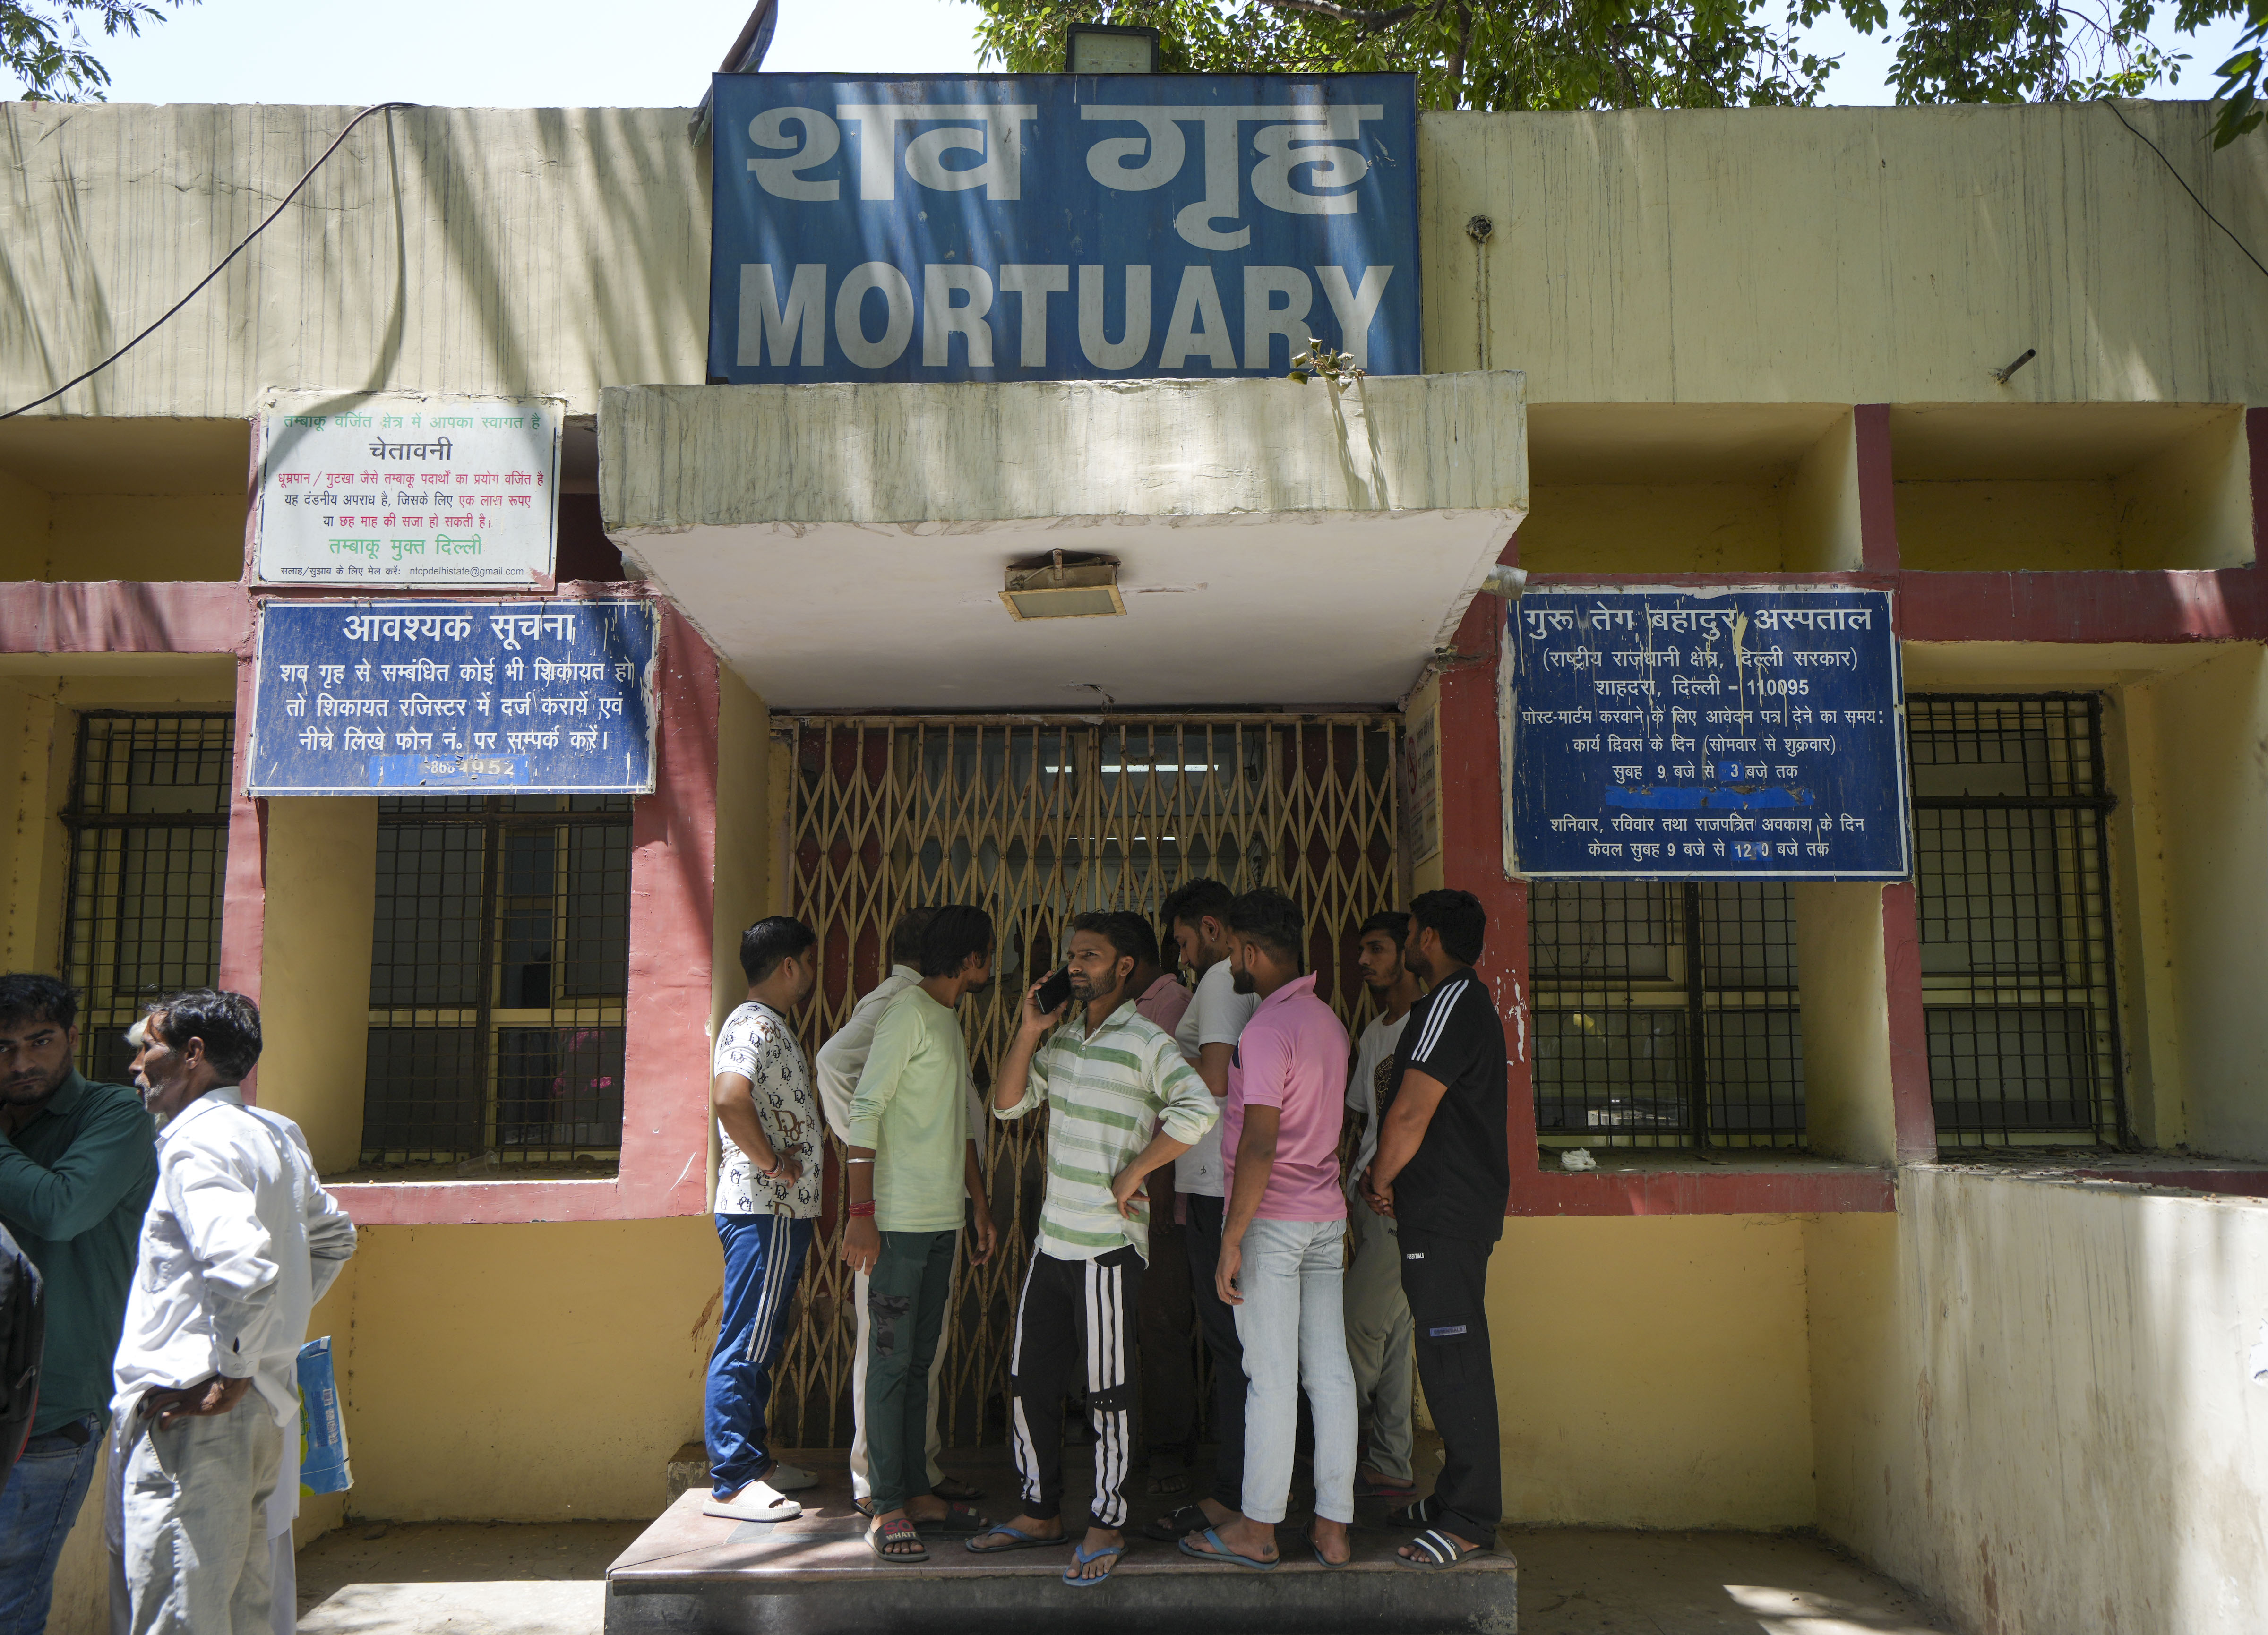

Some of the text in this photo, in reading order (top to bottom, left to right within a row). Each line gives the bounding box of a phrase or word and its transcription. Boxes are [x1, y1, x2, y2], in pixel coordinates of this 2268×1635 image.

[747, 104, 1383, 251] शव गृह
[736, 261, 1394, 370] MORTUARY
[284, 415, 326, 432] तम्बाकू
[335, 412, 371, 430] वर्जित
[412, 414, 421, 428] में
[430, 416, 473, 429] आपका
[482, 416, 524, 429] स्वागत
[531, 413, 541, 430] है
[369, 437, 453, 460] चेतावनी
[278, 473, 310, 488] धूम्रपान
[326, 473, 354, 488] गुटखा
[361, 470, 378, 485] जैसे
[384, 474, 415, 489] तम्बाकू
[456, 474, 468, 485] का
[474, 474, 498, 486] प्रयोग
[505, 471, 531, 486] वर्जित
[538, 471, 544, 486] है
[284, 495, 299, 506] यह
[304, 492, 338, 506] दंडनीय
[343, 495, 375, 506] अपराध
[382, 491, 391, 507] है,
[398, 491, 429, 506] जिसके
[435, 491, 453, 507] लिए
[459, 495, 475, 507] एक
[481, 495, 502, 506] लाख
[324, 516, 334, 527] या
[340, 516, 355, 529] छह
[361, 516, 378, 529] माह
[384, 513, 396, 528] की
[402, 516, 423, 527] सजा
[430, 512, 439, 529] हो
[445, 512, 473, 528] सकती
[329, 533, 482, 560] तम्बाकू मुक्त दिल्ली
[336, 565, 344, 576] के
[348, 565, 363, 576] लिए
[368, 565, 382, 576] मेल
[410, 566, 524, 577] ntcpdelhistate@gmail.com
[344, 615, 575, 650] आवश्यक सूचना
[1590, 601, 1633, 631] तेग
[1649, 609, 1738, 640] बहादुर
[1755, 608, 1872, 631] अस्पताल
[1612, 646, 1680, 667] राजधानी
[1736, 646, 1784, 668] दिल्ली
[1793, 647, 1858, 671] सरकार)
[280, 656, 633, 688] शव गृह से सम्बंधित कोई भी शिकायत हो
[1596, 680, 1662, 698] शाहदरा,
[1673, 674, 1721, 697] दिल्ली
[1747, 679, 1809, 696] 110095
[286, 691, 623, 719] तो शिकायत रजिस्टर में दर्ज करायें एवं
[1600, 705, 1644, 724] करवाने
[1650, 705, 1664, 724] के
[1672, 705, 1697, 725] लिए
[1706, 705, 1753, 724] आवेदन
[1761, 710, 1781, 725] पत्र
[1792, 705, 1812, 724] देने
[1820, 710, 1837, 724] का
[299, 725, 334, 751] नीचे
[344, 725, 386, 751] लिखे
[396, 726, 433, 751] फोन
[473, 732, 498, 749] पर
[507, 725, 560, 749] सम्पर्क
[570, 724, 608, 750] करें।
[1573, 733, 1836, 757] कार्य दिवस के दिन (सोमवार से शुक्रवार)
[1612, 761, 1798, 785] सुबह 9 बजे से 3 बजे तक
[1550, 813, 1864, 834] शनिवार, रविवार तथा राजपत्रित अवकाश के दिन
[1588, 838, 1623, 857] केवल
[1631, 843, 1660, 862] सुबह
[1667, 843, 1675, 857] 9
[1684, 838, 1706, 857] बजे
[1713, 838, 1725, 857] से
[1778, 838, 1799, 857] बजे
[1807, 843, 1830, 857] तक
[884, 1519, 913, 1535] SO
